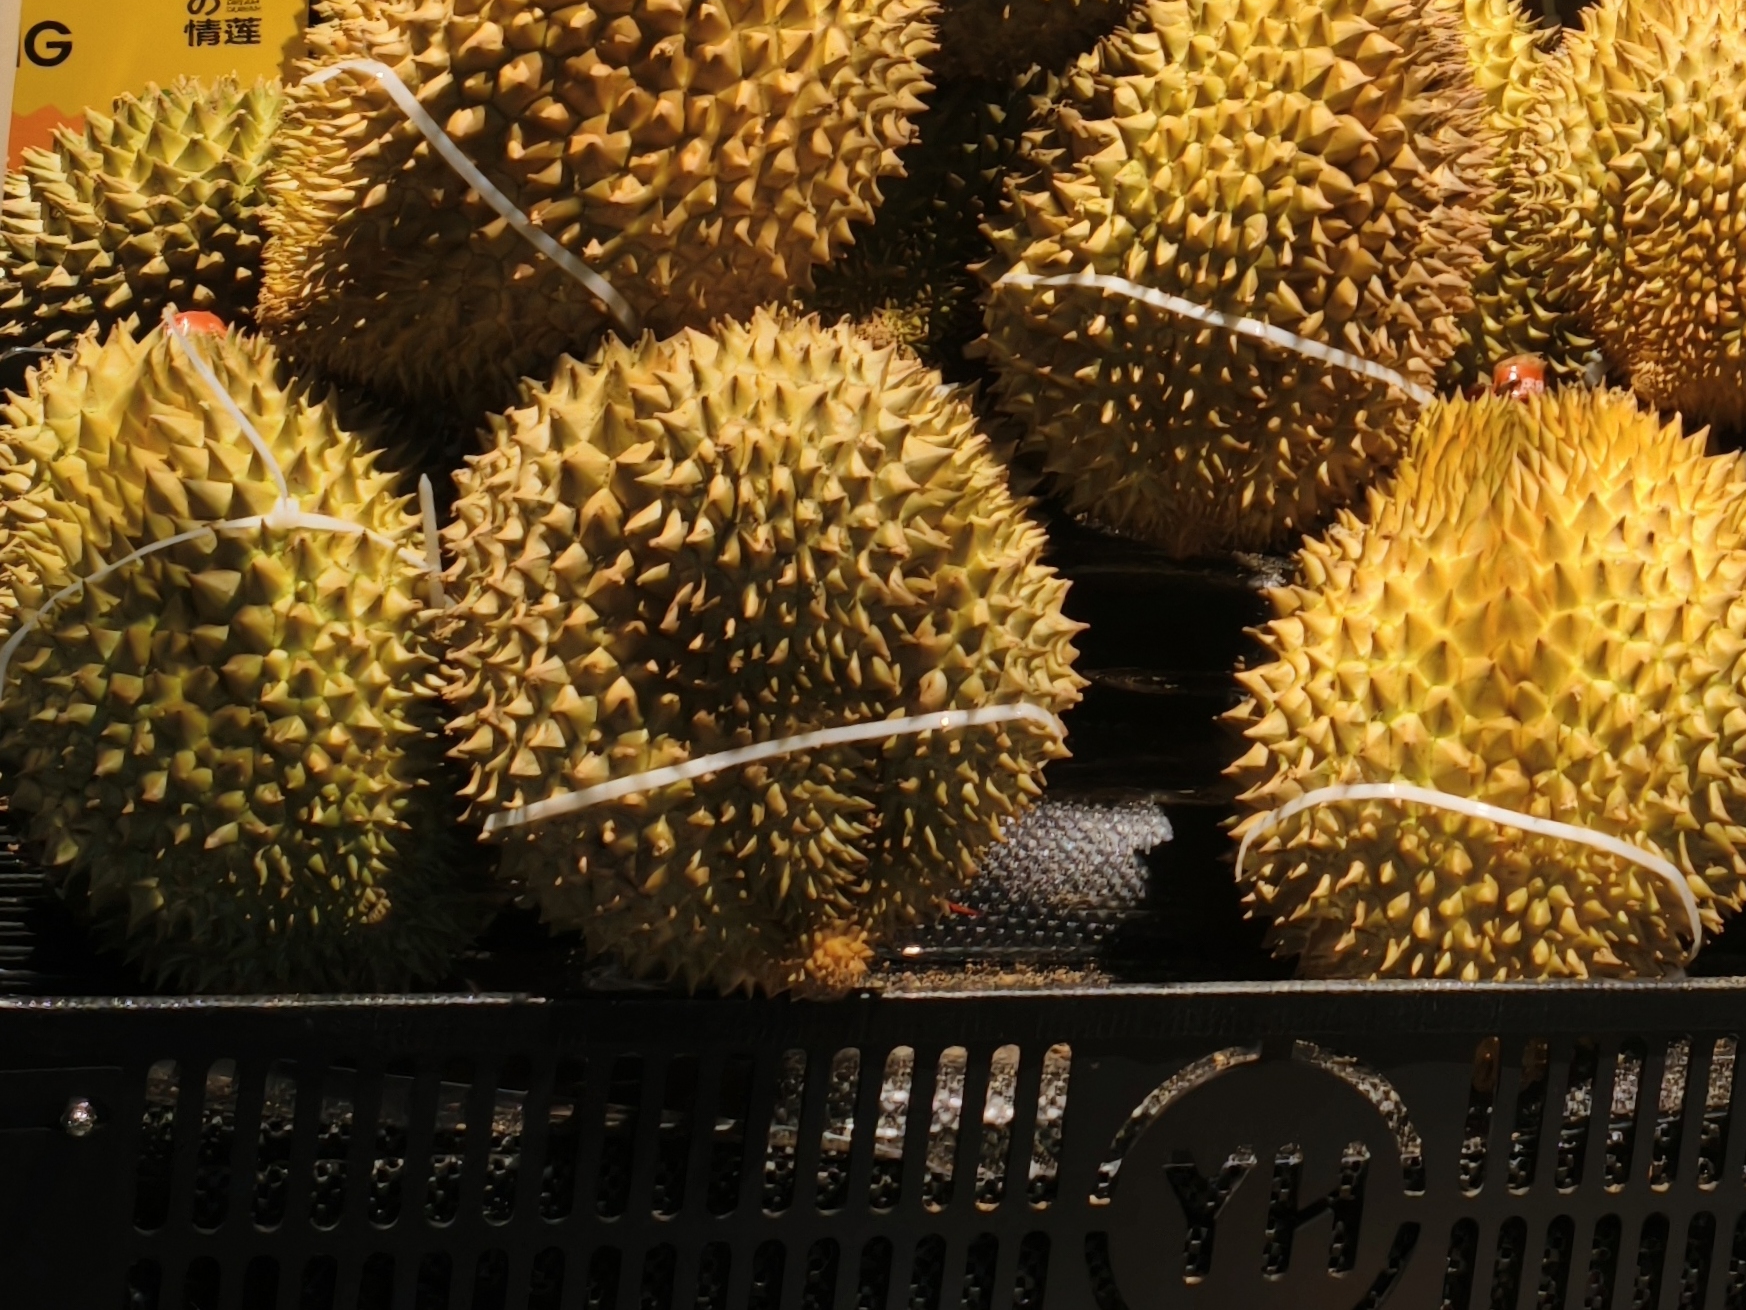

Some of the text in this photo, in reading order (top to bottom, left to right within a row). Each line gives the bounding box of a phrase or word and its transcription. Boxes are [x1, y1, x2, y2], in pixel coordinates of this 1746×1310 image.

[16, 20, 73, 68] G
[184, 17, 262, 47] 情莲
[1163, 1142, 1371, 1284] YH
